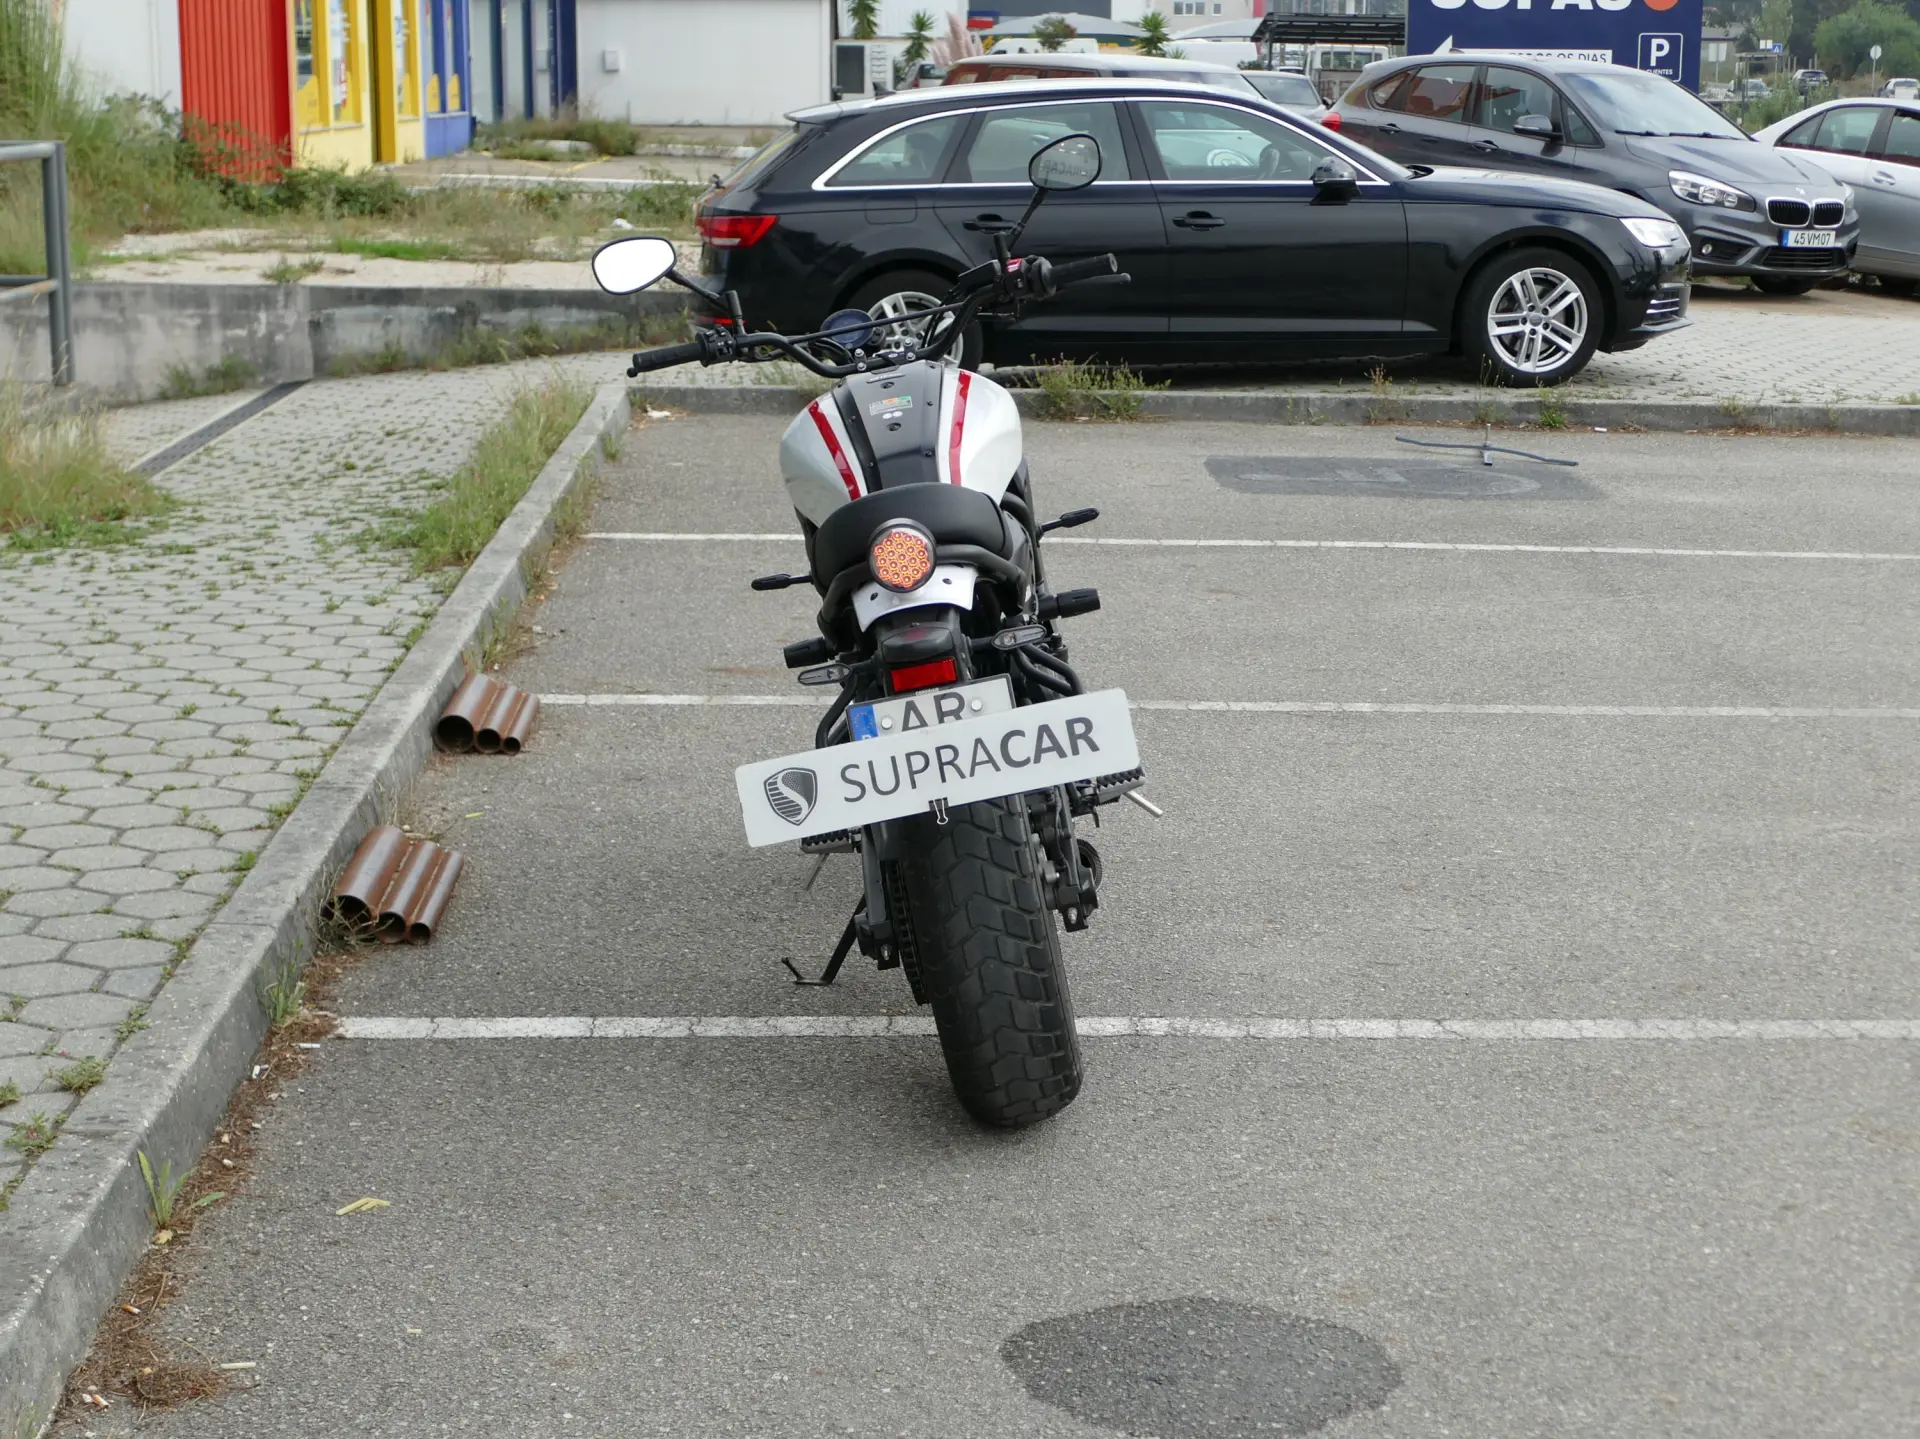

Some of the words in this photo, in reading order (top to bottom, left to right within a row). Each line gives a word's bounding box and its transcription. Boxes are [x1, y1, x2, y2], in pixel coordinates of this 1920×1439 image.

[1650, 38, 1670, 66] P
[902, 691, 966, 732] AR
[840, 716, 1100, 803] SUPRACAR
